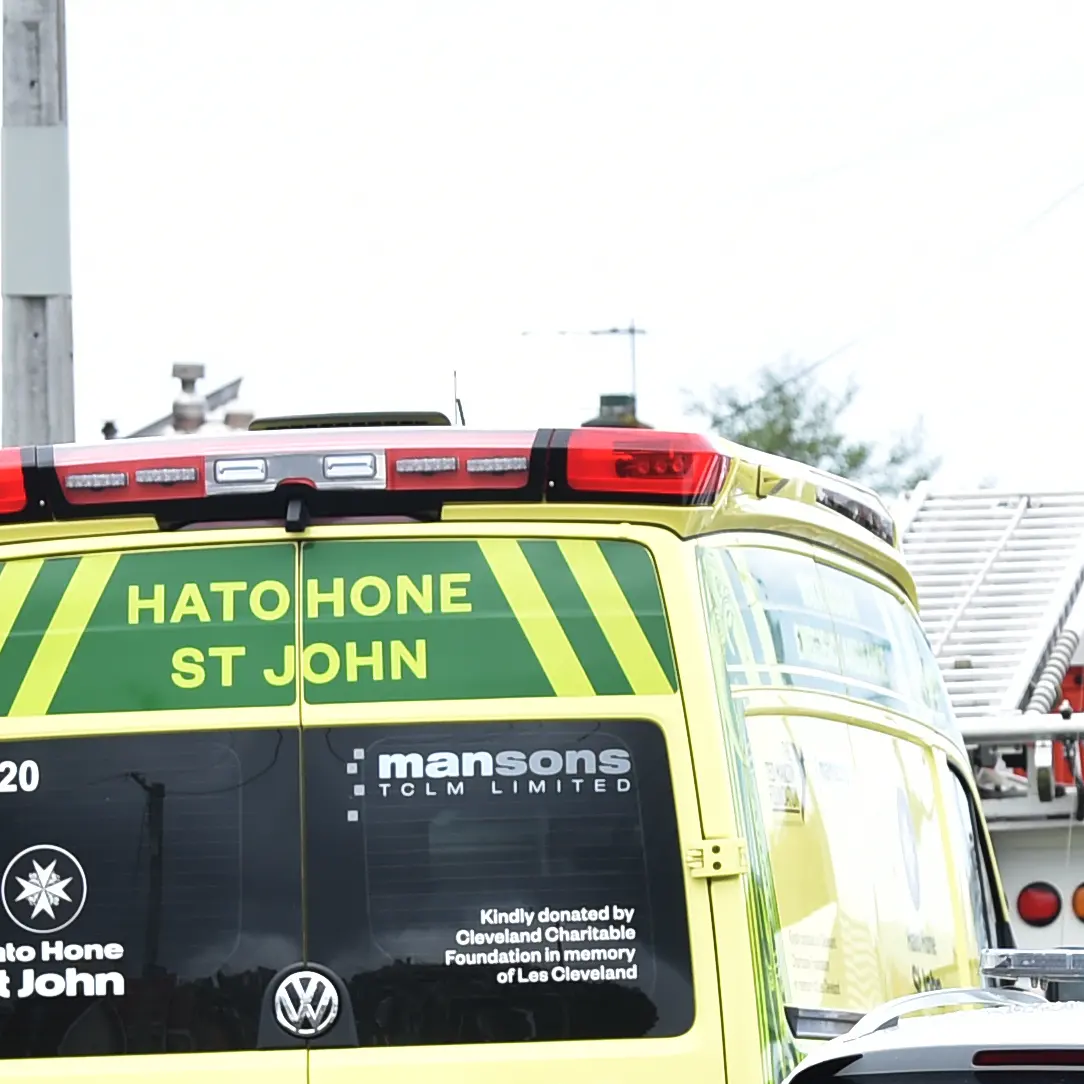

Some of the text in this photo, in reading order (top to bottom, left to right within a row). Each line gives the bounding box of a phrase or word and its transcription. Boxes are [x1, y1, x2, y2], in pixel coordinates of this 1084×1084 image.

[128, 573, 472, 624] HATO HONE
[171, 639, 427, 688] ST JOHN
[379, 749, 631, 779] mansons
[379, 779, 631, 797] TCLM LIMITED
[480, 905, 635, 926] Kindly donated by
[456, 925, 636, 945] Cleveland Charitable
[41, 940, 124, 961] Hone
[445, 947, 636, 966] Foundation in memory
[18, 967, 125, 998] John
[497, 964, 638, 984] of Les Cleveland
